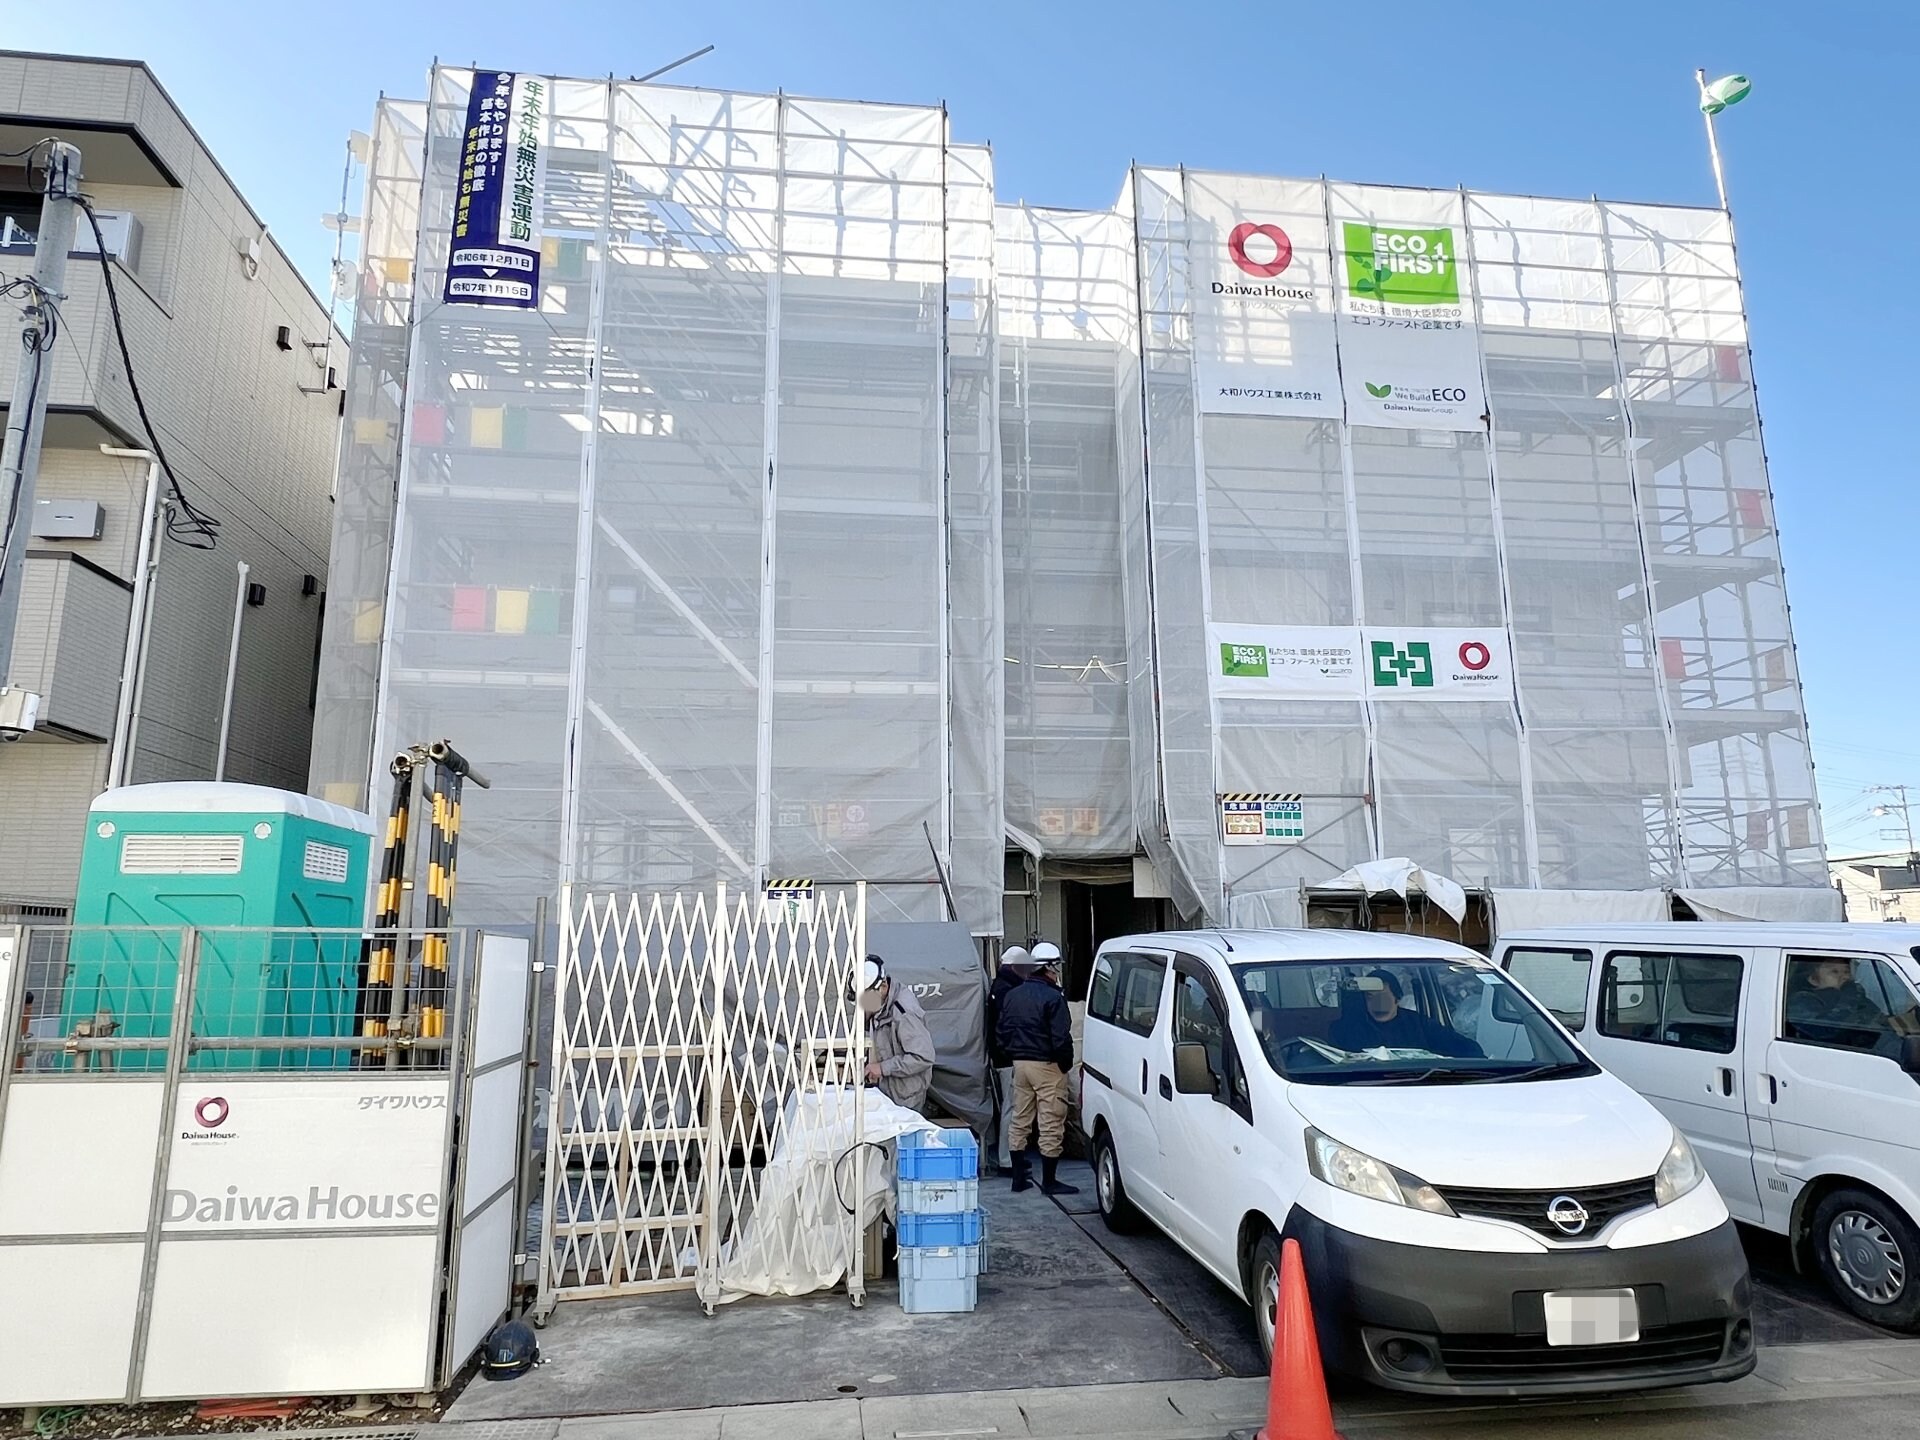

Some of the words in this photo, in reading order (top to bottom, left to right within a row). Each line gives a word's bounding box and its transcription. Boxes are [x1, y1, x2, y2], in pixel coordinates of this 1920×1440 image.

[488, 72, 512, 176] 今年もやります!
[471, 97, 494, 192] 基本作業の徹底
[509, 81, 544, 242] 年末年始無災害運動
[456, 127, 479, 238] 年末年始も無災害
[1372, 232, 1428, 254] ECO
[456, 253, 530, 268] 令和6年12月1日
[452, 282, 529, 297] 令和7年1月15日
[1211, 281, 1263, 297] Daiwa
[1264, 284, 1314, 300] House
[1219, 387, 1322, 401] 大和ハウス工業株式会社
[1431, 388, 1466, 402] ECO
[1232, 646, 1256, 656] ECO
[358, 1095, 447, 1110] ダイワハウス
[182, 1131, 209, 1140] Daiwa
[210, 1131, 237, 1139] House
[162, 1185, 299, 1223] Daiwa
[306, 1186, 439, 1220] House
